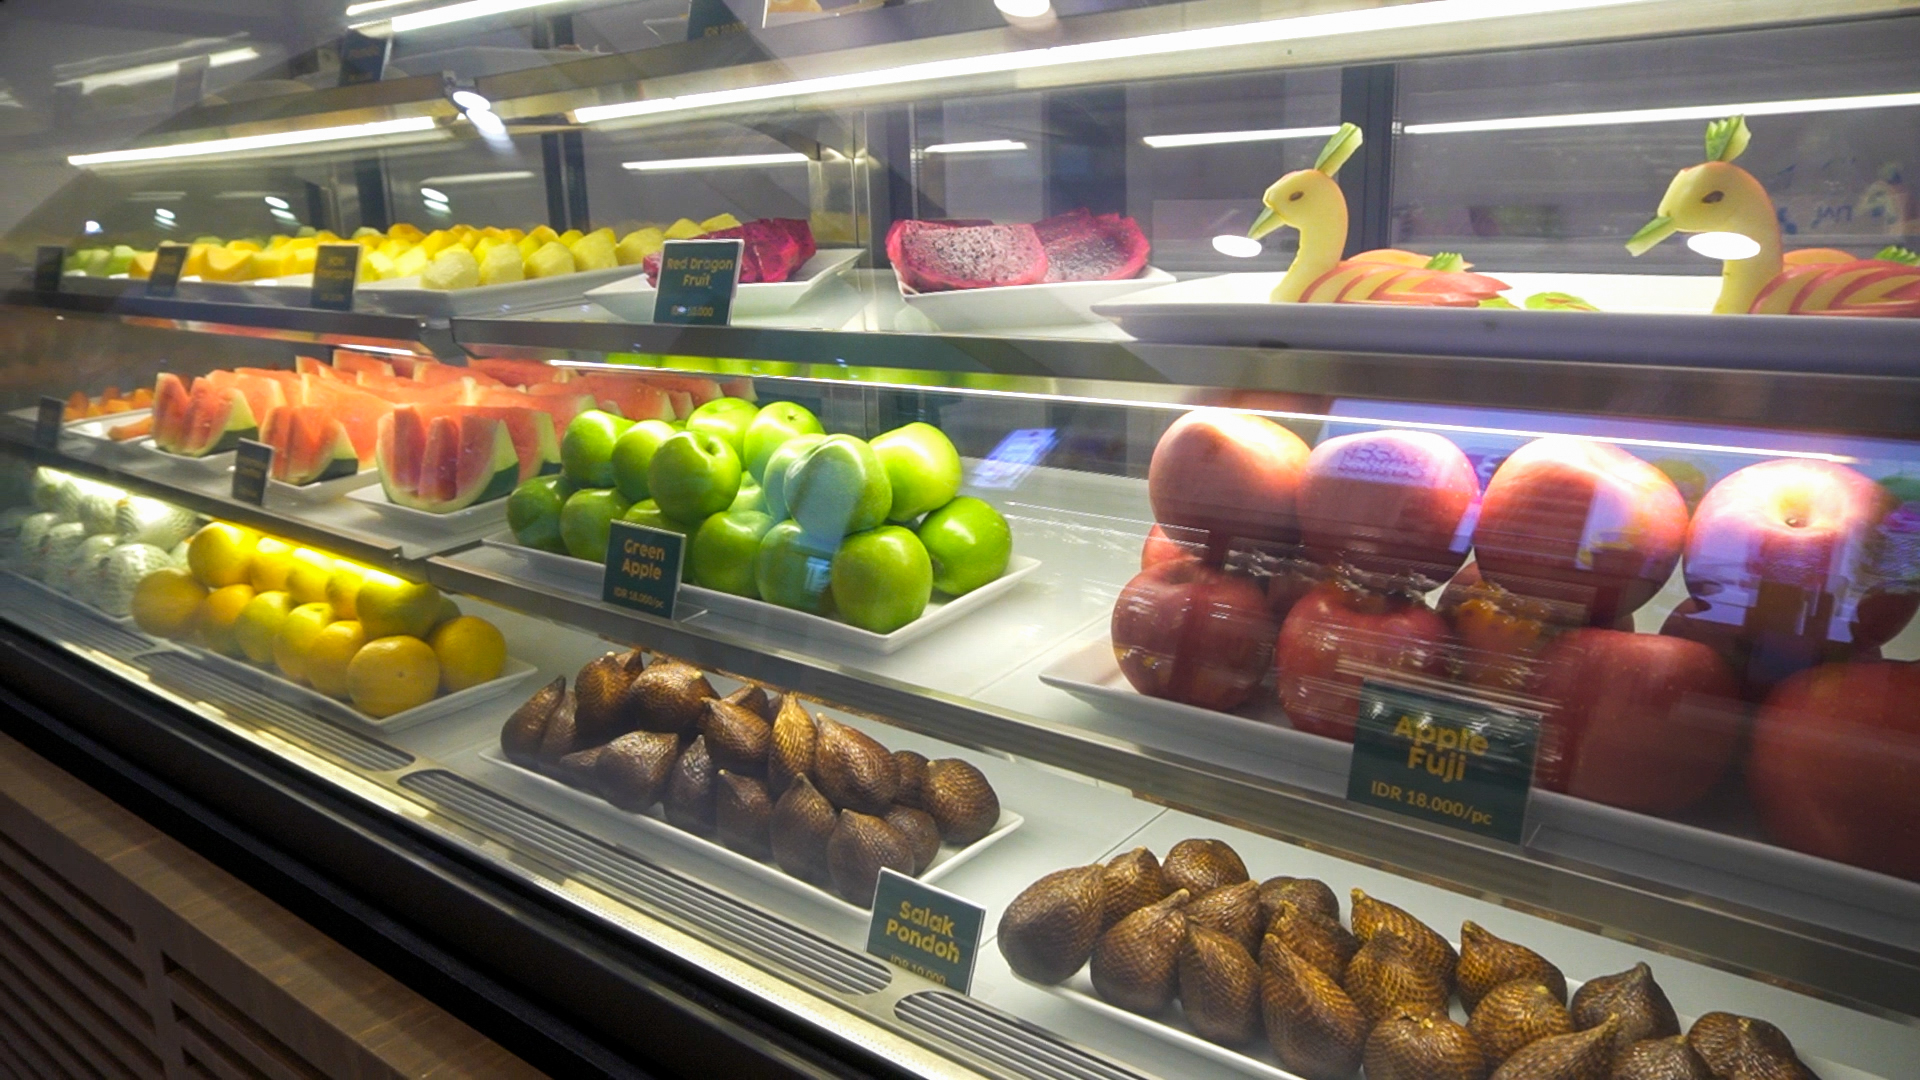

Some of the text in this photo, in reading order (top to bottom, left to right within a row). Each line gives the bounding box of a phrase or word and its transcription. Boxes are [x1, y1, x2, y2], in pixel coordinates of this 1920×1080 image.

[667, 257, 734, 273] Red Dragon
[683, 273, 711, 287] Fruit
[624, 539, 665, 562] Green
[621, 558, 663, 580] Apple
[613, 586, 628, 599] IDR
[1393, 715, 1490, 756] Apple
[1407, 745, 1467, 783] Fuji
[1371, 780, 1493, 826] IDR 18.000/pc
[899, 901, 956, 938] Salak
[885, 918, 961, 964] Pondoh
